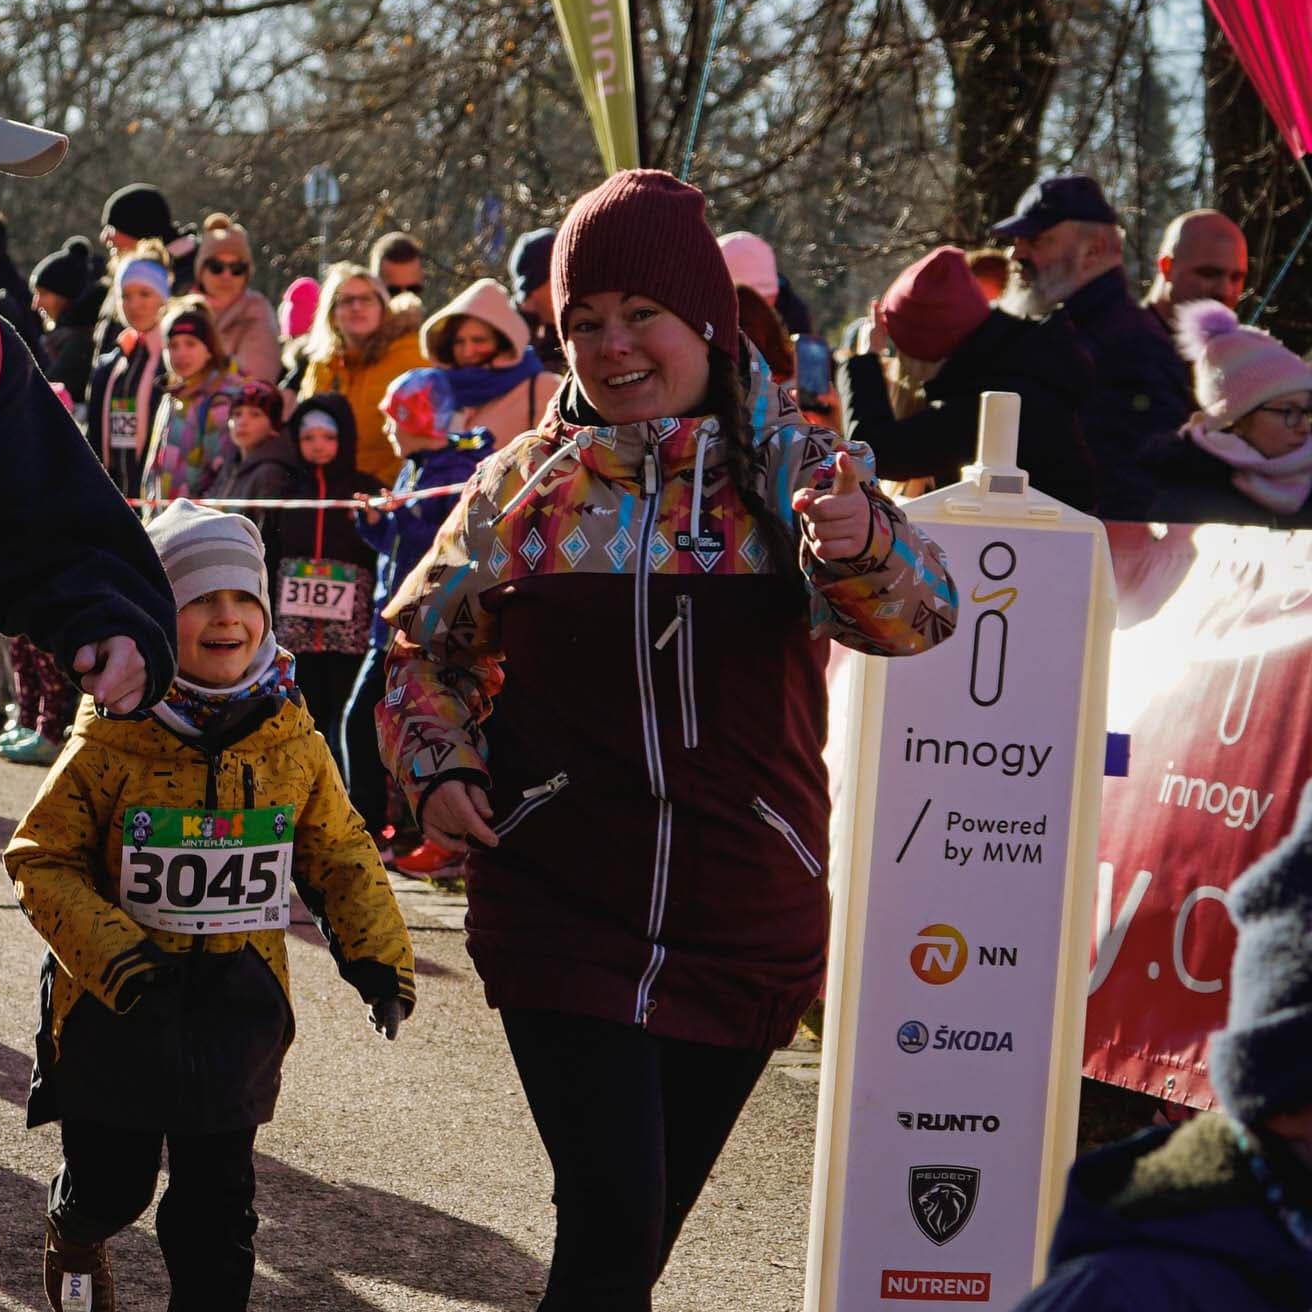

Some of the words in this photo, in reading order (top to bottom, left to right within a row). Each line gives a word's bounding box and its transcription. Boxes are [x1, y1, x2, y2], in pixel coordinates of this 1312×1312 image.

[287, 581, 346, 606] 3187
[905, 728, 1053, 777] innogy
[1160, 763, 1274, 831] innogy
[947, 812, 1047, 835] Powered
[945, 839, 973, 866] by
[984, 841, 1042, 864] MVM
[127, 851, 280, 907] 3045
[979, 947, 1018, 966] NN
[933, 1026, 1013, 1052] ŠKODA
[917, 1113, 1000, 1132] RUNTO
[916, 1172, 974, 1181] PEUGEOT
[888, 1277, 986, 1295] NUTREND
